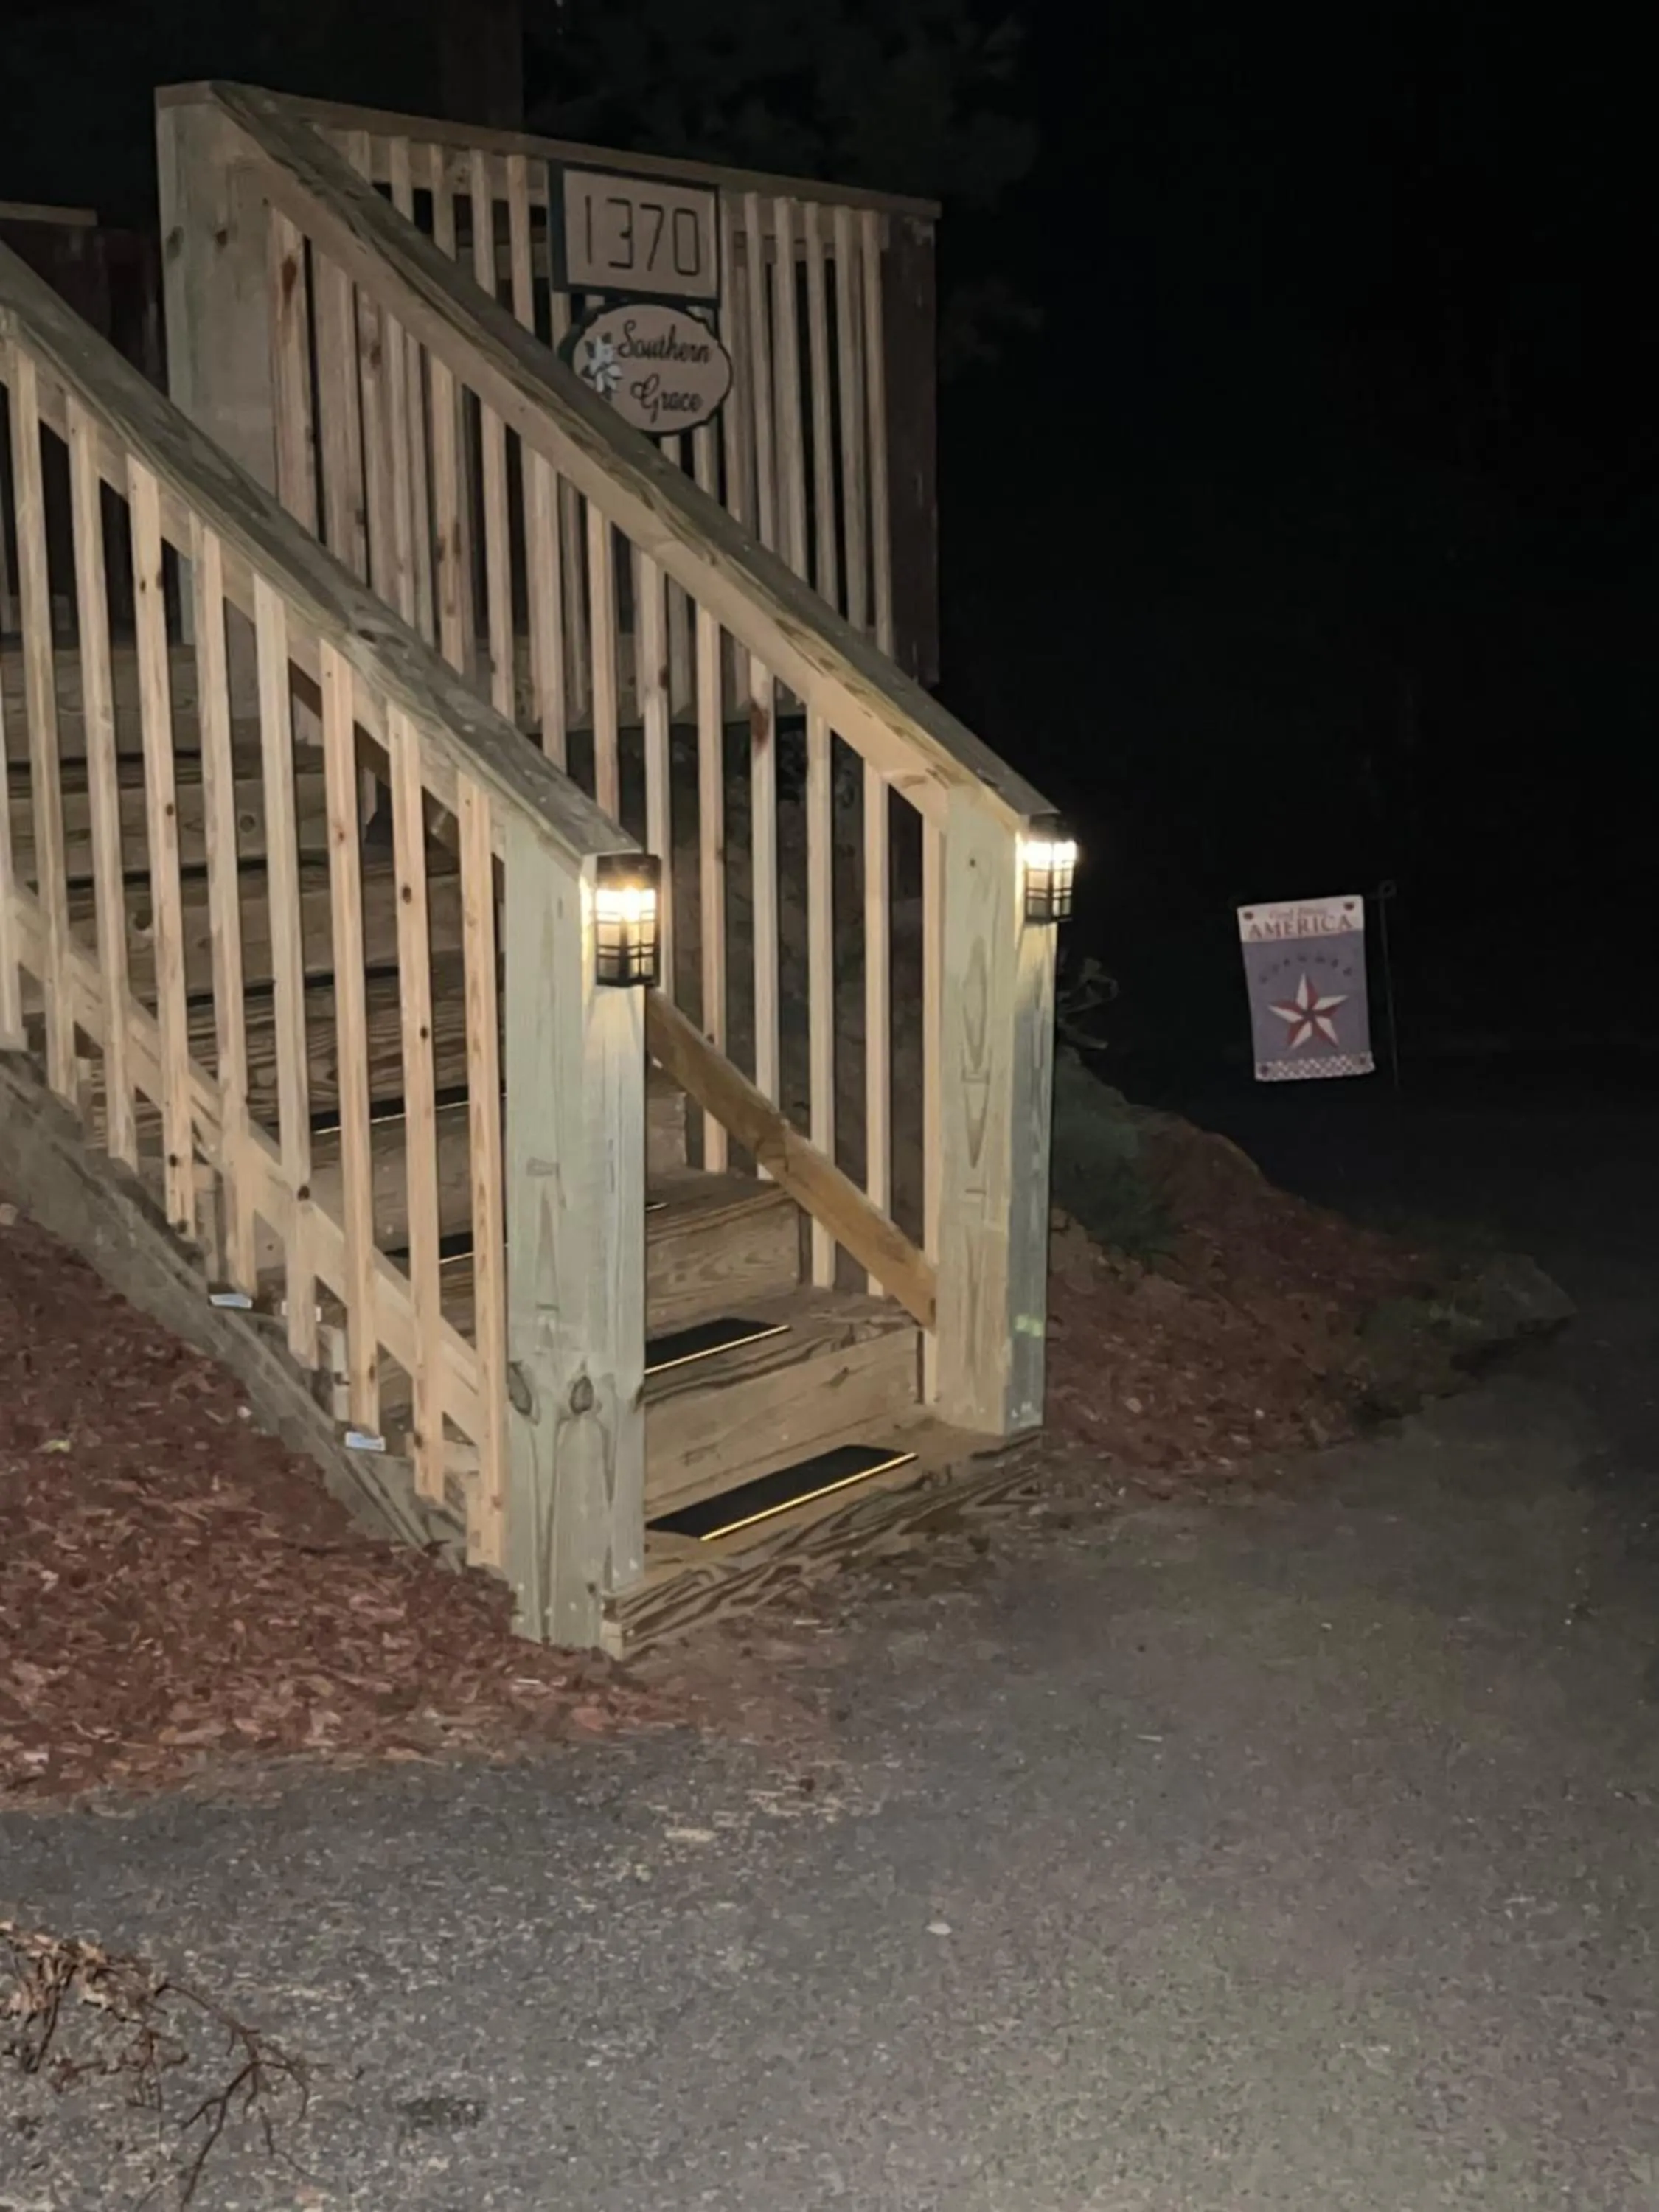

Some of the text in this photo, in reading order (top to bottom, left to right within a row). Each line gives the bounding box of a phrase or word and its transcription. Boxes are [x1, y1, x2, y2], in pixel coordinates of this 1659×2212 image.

[585, 195, 700, 276] 1370
[617, 319, 712, 364] Southern
[630, 373, 703, 423] Grace
[1248, 914, 1352, 939] AMERICA
